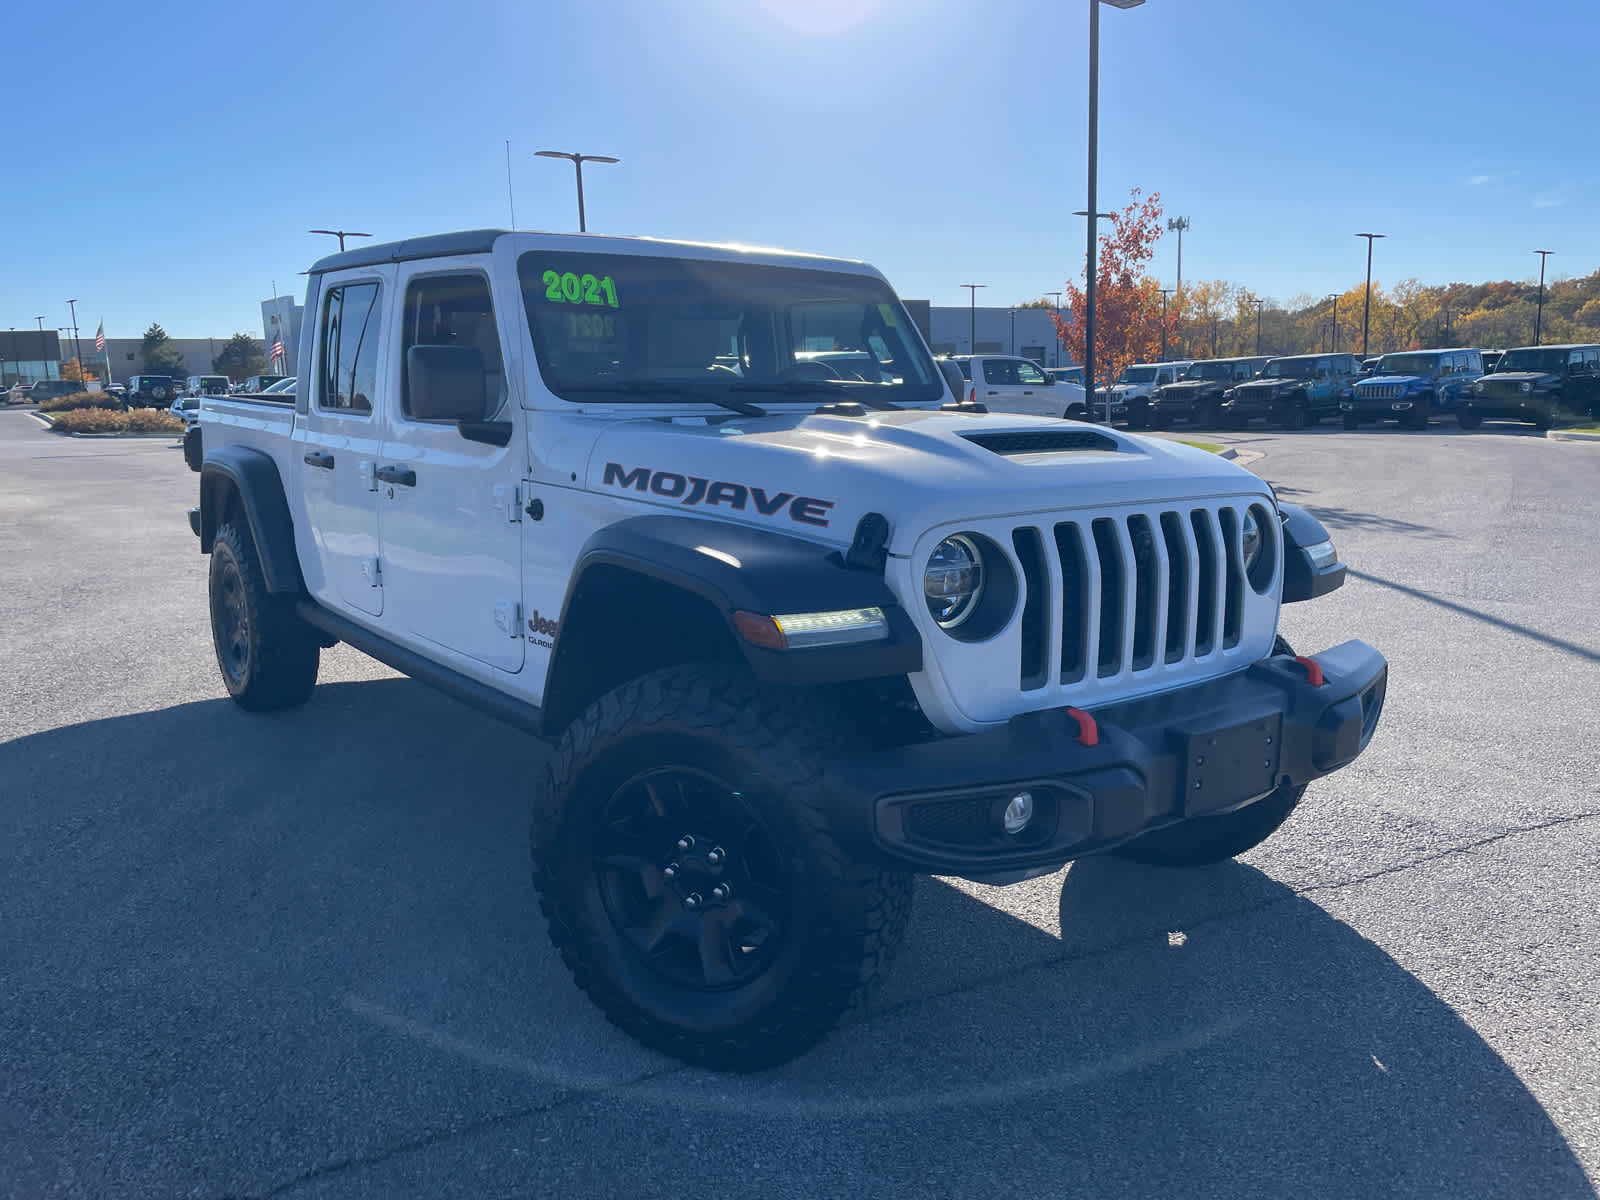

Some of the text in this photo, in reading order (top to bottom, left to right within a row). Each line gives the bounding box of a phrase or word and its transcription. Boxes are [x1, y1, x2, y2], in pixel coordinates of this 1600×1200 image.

[543, 270, 619, 308] 2021
[603, 462, 835, 528] MOJAVE
[528, 609, 558, 638] Jee
